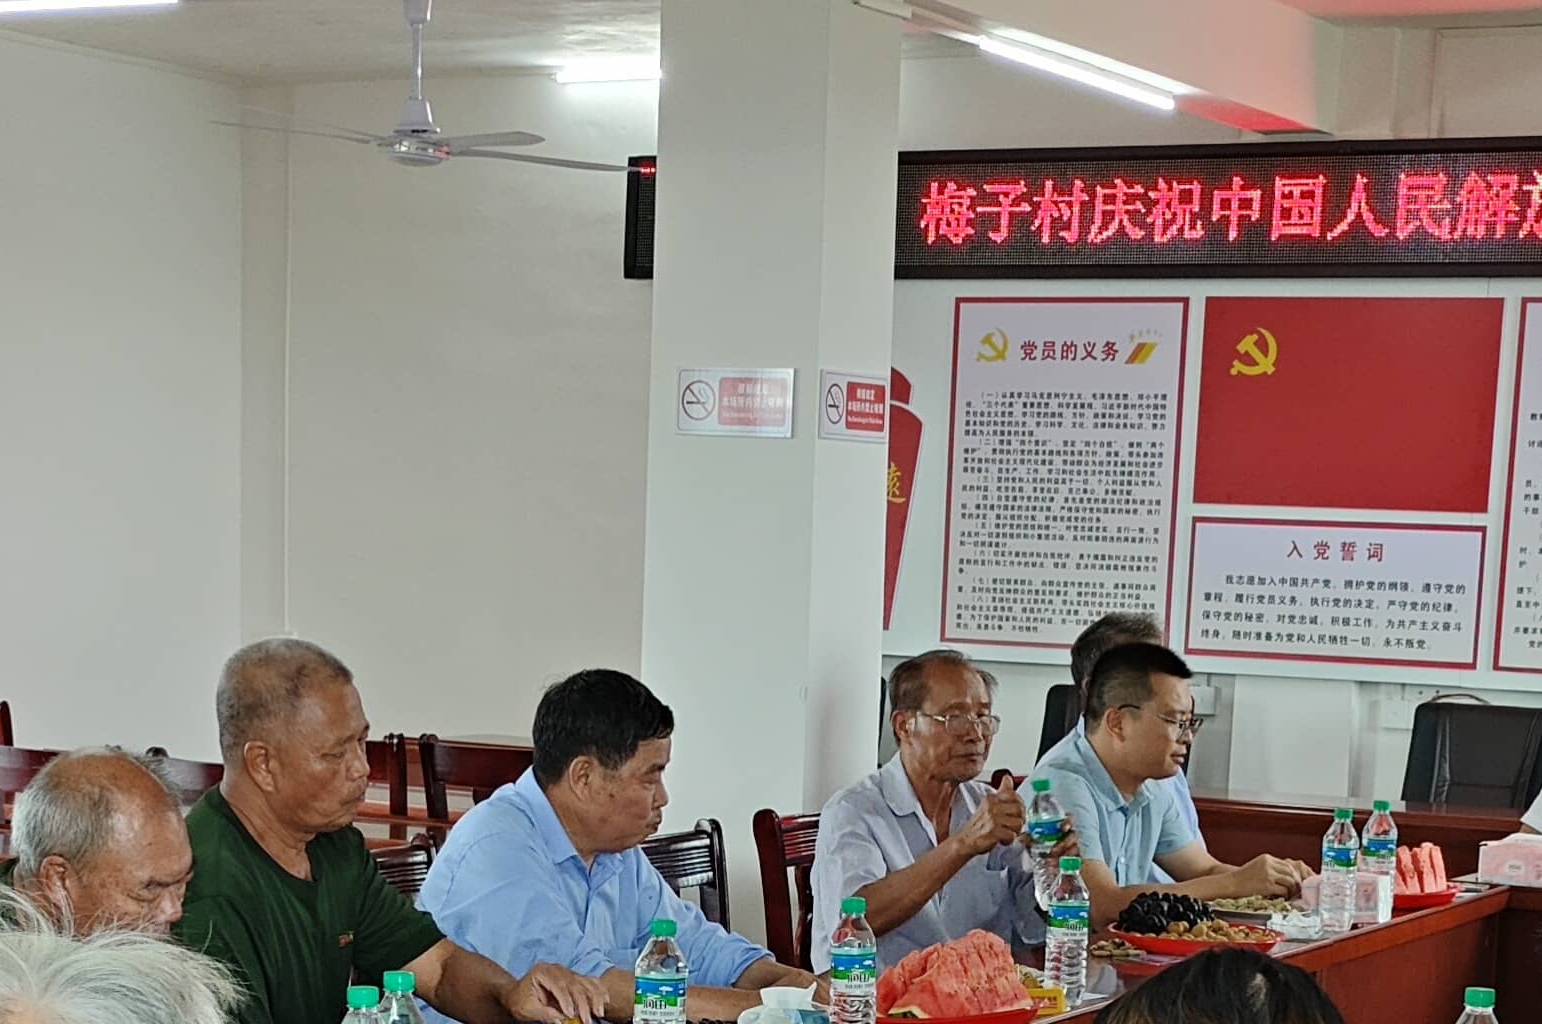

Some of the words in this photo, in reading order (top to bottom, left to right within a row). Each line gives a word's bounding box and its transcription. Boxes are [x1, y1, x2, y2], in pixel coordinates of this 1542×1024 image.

[1018, 339, 1120, 363] 党员的义务
[1285, 537, 1384, 563] 入党誓词
